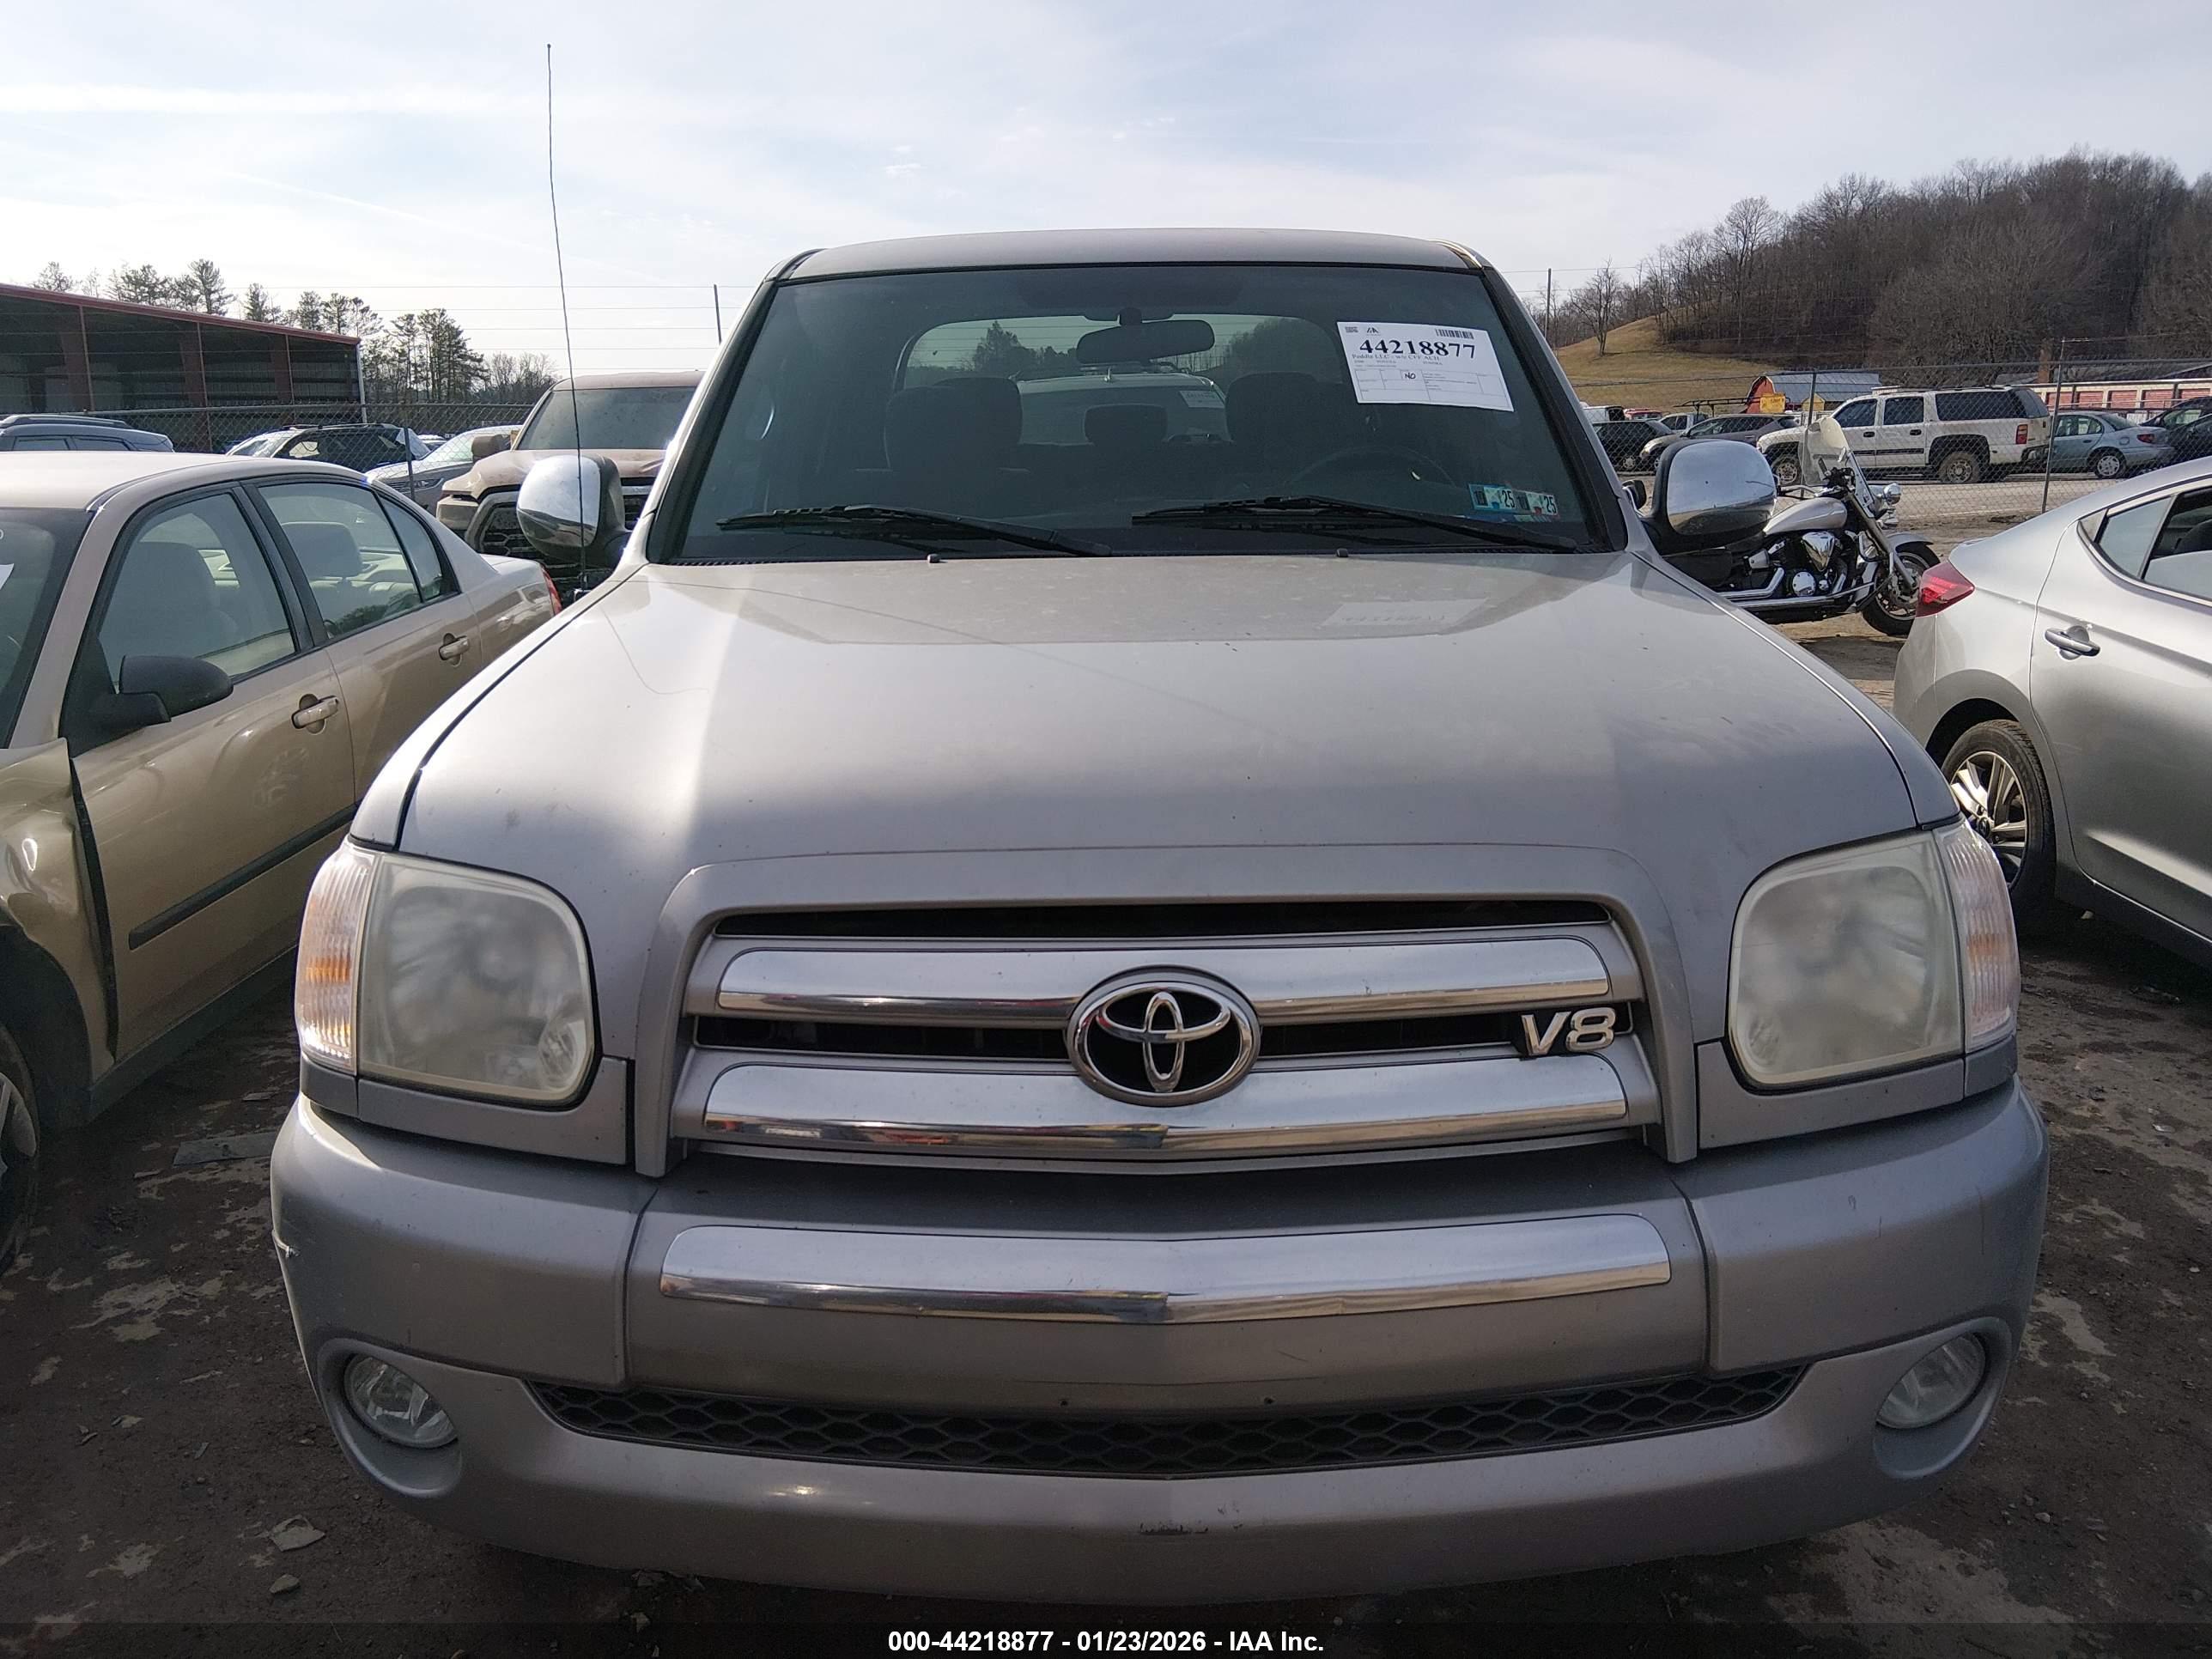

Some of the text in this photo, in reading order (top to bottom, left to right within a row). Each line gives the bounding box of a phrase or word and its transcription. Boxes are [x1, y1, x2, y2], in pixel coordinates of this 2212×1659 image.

[1359, 339, 1475, 359] 44218877
[1502, 489, 1516, 508] 25
[1543, 495, 1557, 514] 25
[1521, 1006, 1616, 1056] V8
